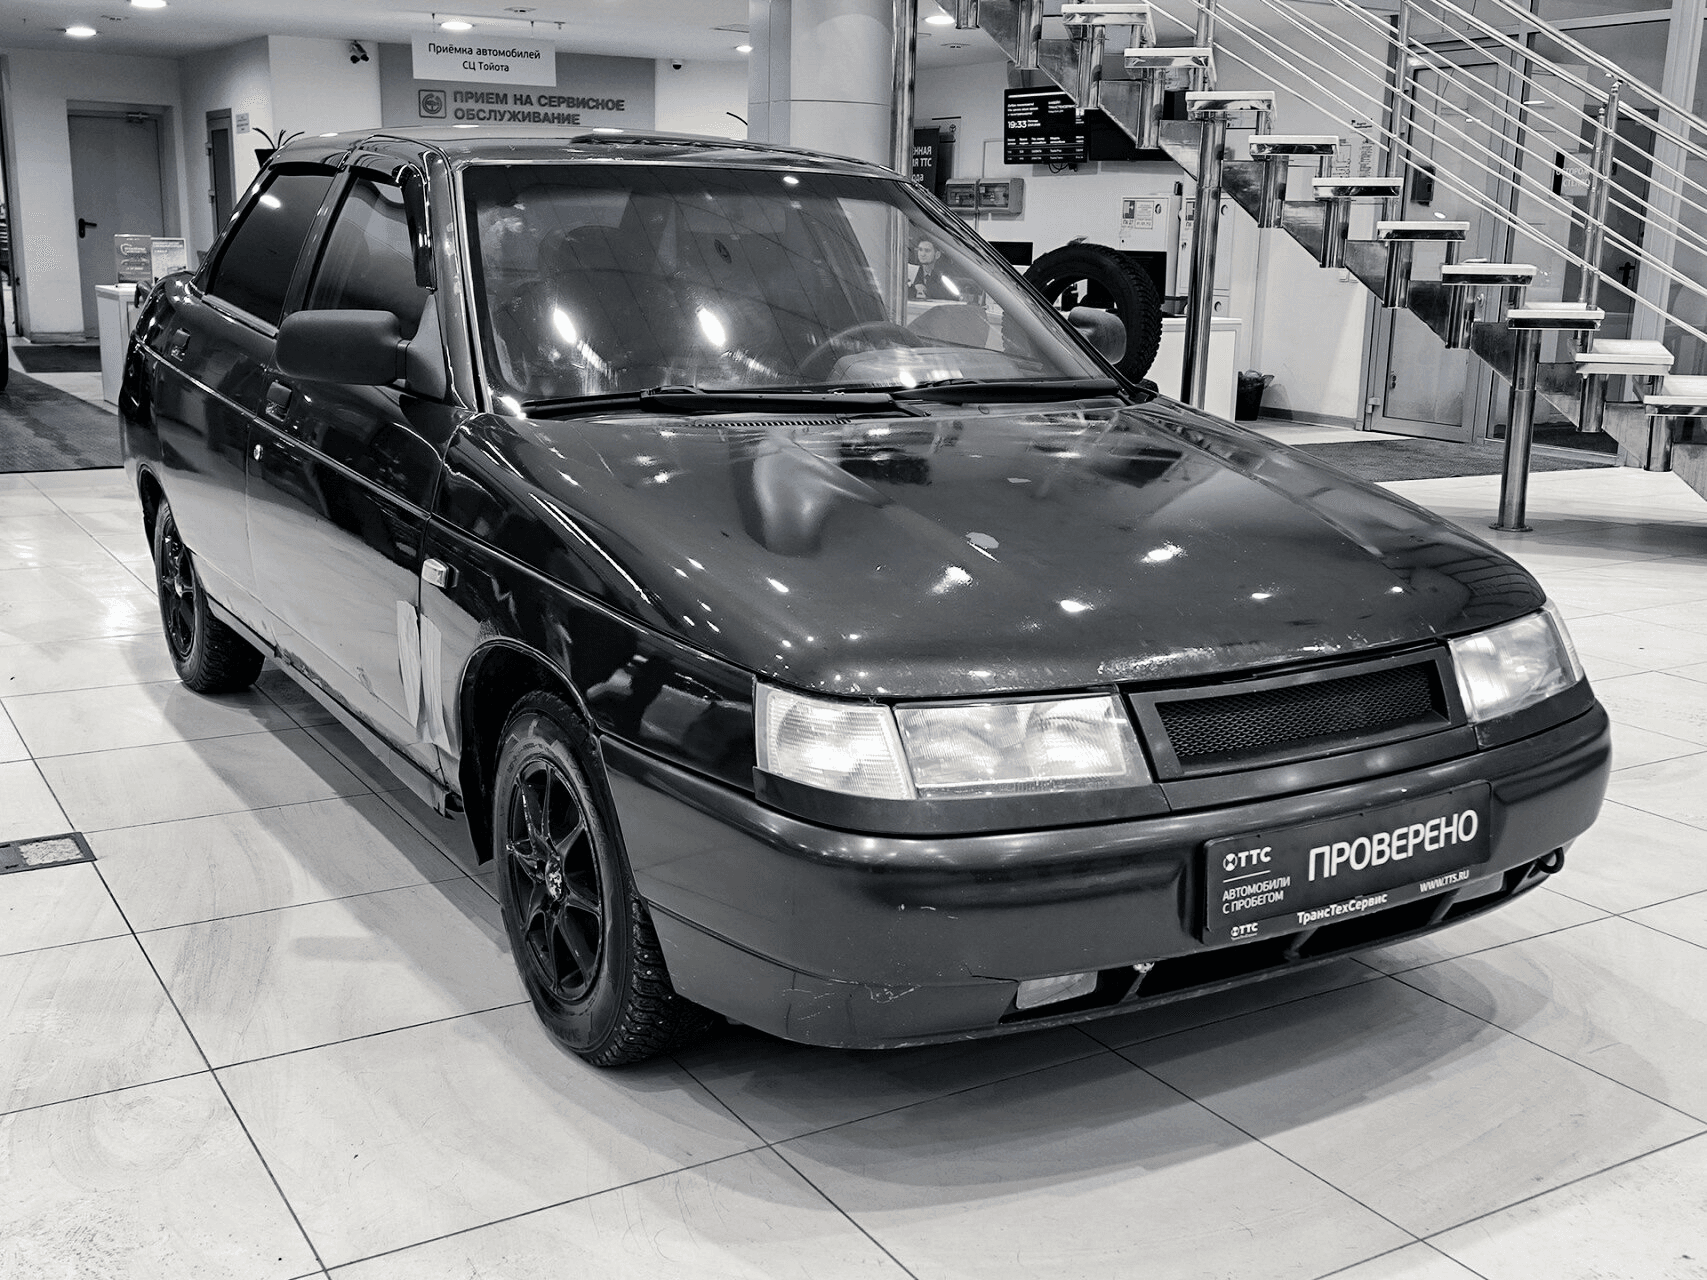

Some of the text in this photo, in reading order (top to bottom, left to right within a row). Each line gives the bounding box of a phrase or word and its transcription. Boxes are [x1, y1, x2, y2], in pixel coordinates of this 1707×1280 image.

[428, 42, 541, 60] Приёмка автомобилей
[462, 60, 510, 72] СЦ Тойота
[453, 91, 625, 111] ПРИЕМ НА СЕРВИСНОЕ
[454, 107, 580, 125] ОБСЛУЖИВАНИЕ
[1007, 120, 1027, 129] 19:33
[1308, 809, 1478, 882] ПРОВЕРЕНО
[1237, 846, 1272, 868] ТТС
[1222, 876, 1291, 902] АВТОМОБИЛИ
[1419, 870, 1470, 892] WWW.TTS.RU
[1222, 890, 1284, 914] С ПРОБЕГОМ
[1297, 894, 1388, 925] ТрансТехСервис
[1239, 922, 1258, 935] ТТС
